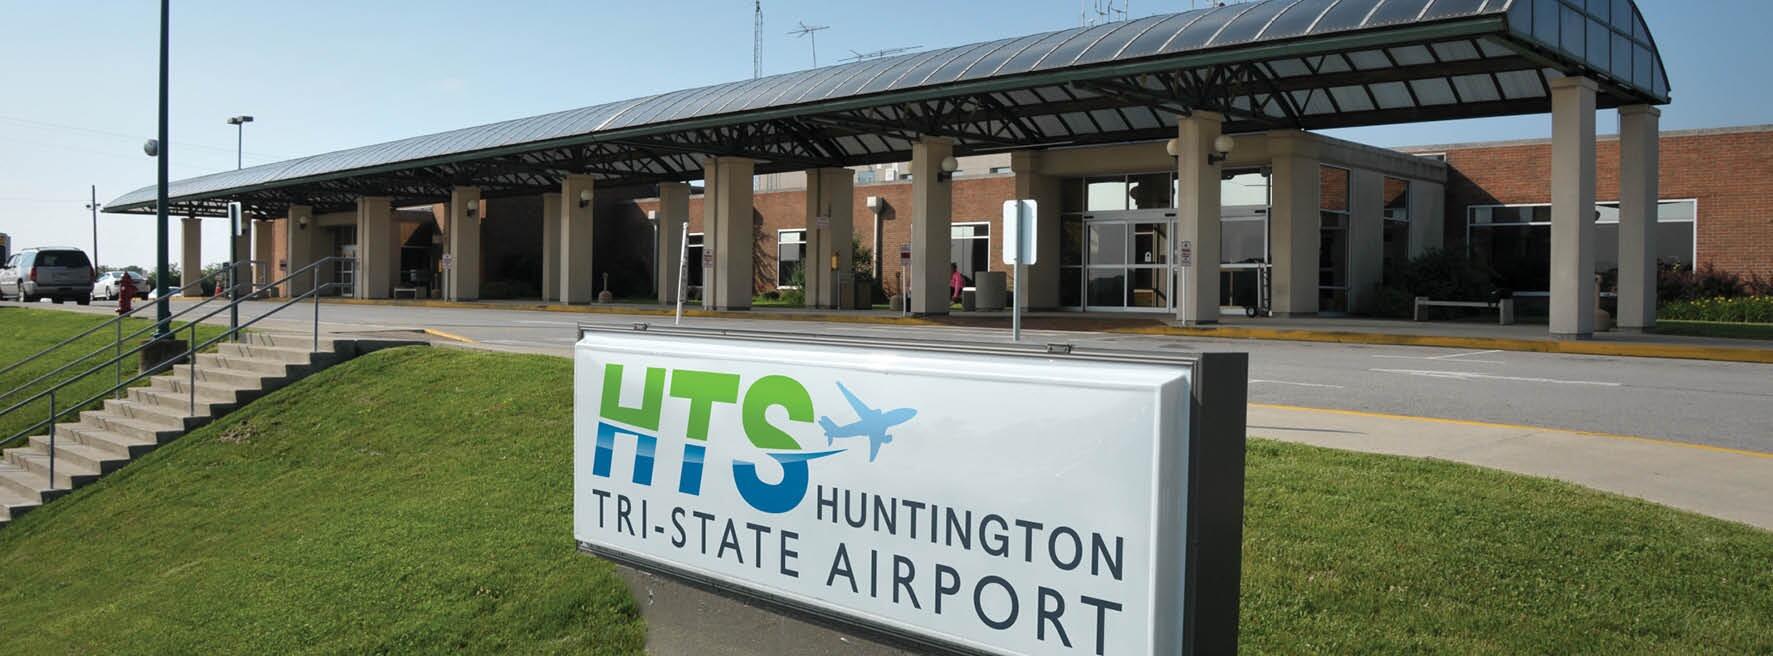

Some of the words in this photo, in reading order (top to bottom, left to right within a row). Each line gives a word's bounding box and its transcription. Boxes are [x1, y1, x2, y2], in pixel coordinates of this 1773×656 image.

[591, 363, 822, 514] HTS
[591, 488, 800, 579] TRI-STATE
[825, 542, 1123, 656] AIRPORT
[816, 484, 1124, 581] HUNTINGTON
